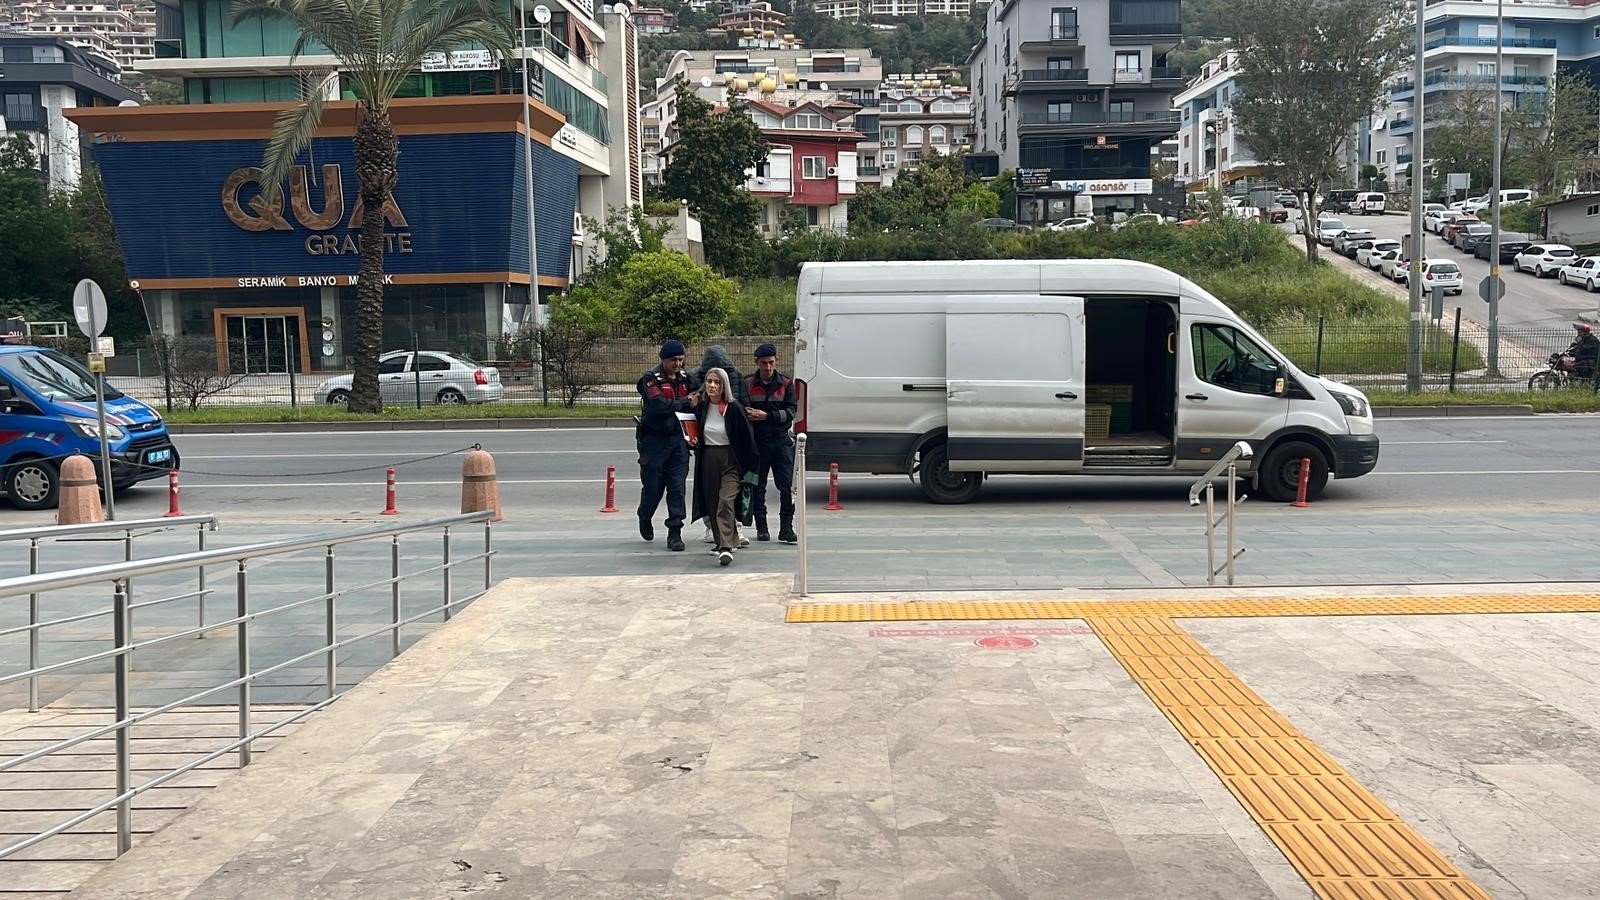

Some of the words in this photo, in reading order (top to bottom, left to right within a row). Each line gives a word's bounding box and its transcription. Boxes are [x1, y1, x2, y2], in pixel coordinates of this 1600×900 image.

[1066, 182, 1086, 193] bilgi
[1089, 182, 1128, 191] asansör
[304, 233, 413, 255] GRATE
[238, 275, 287, 287] SERAMİK
[298, 276, 337, 286] BANYO
